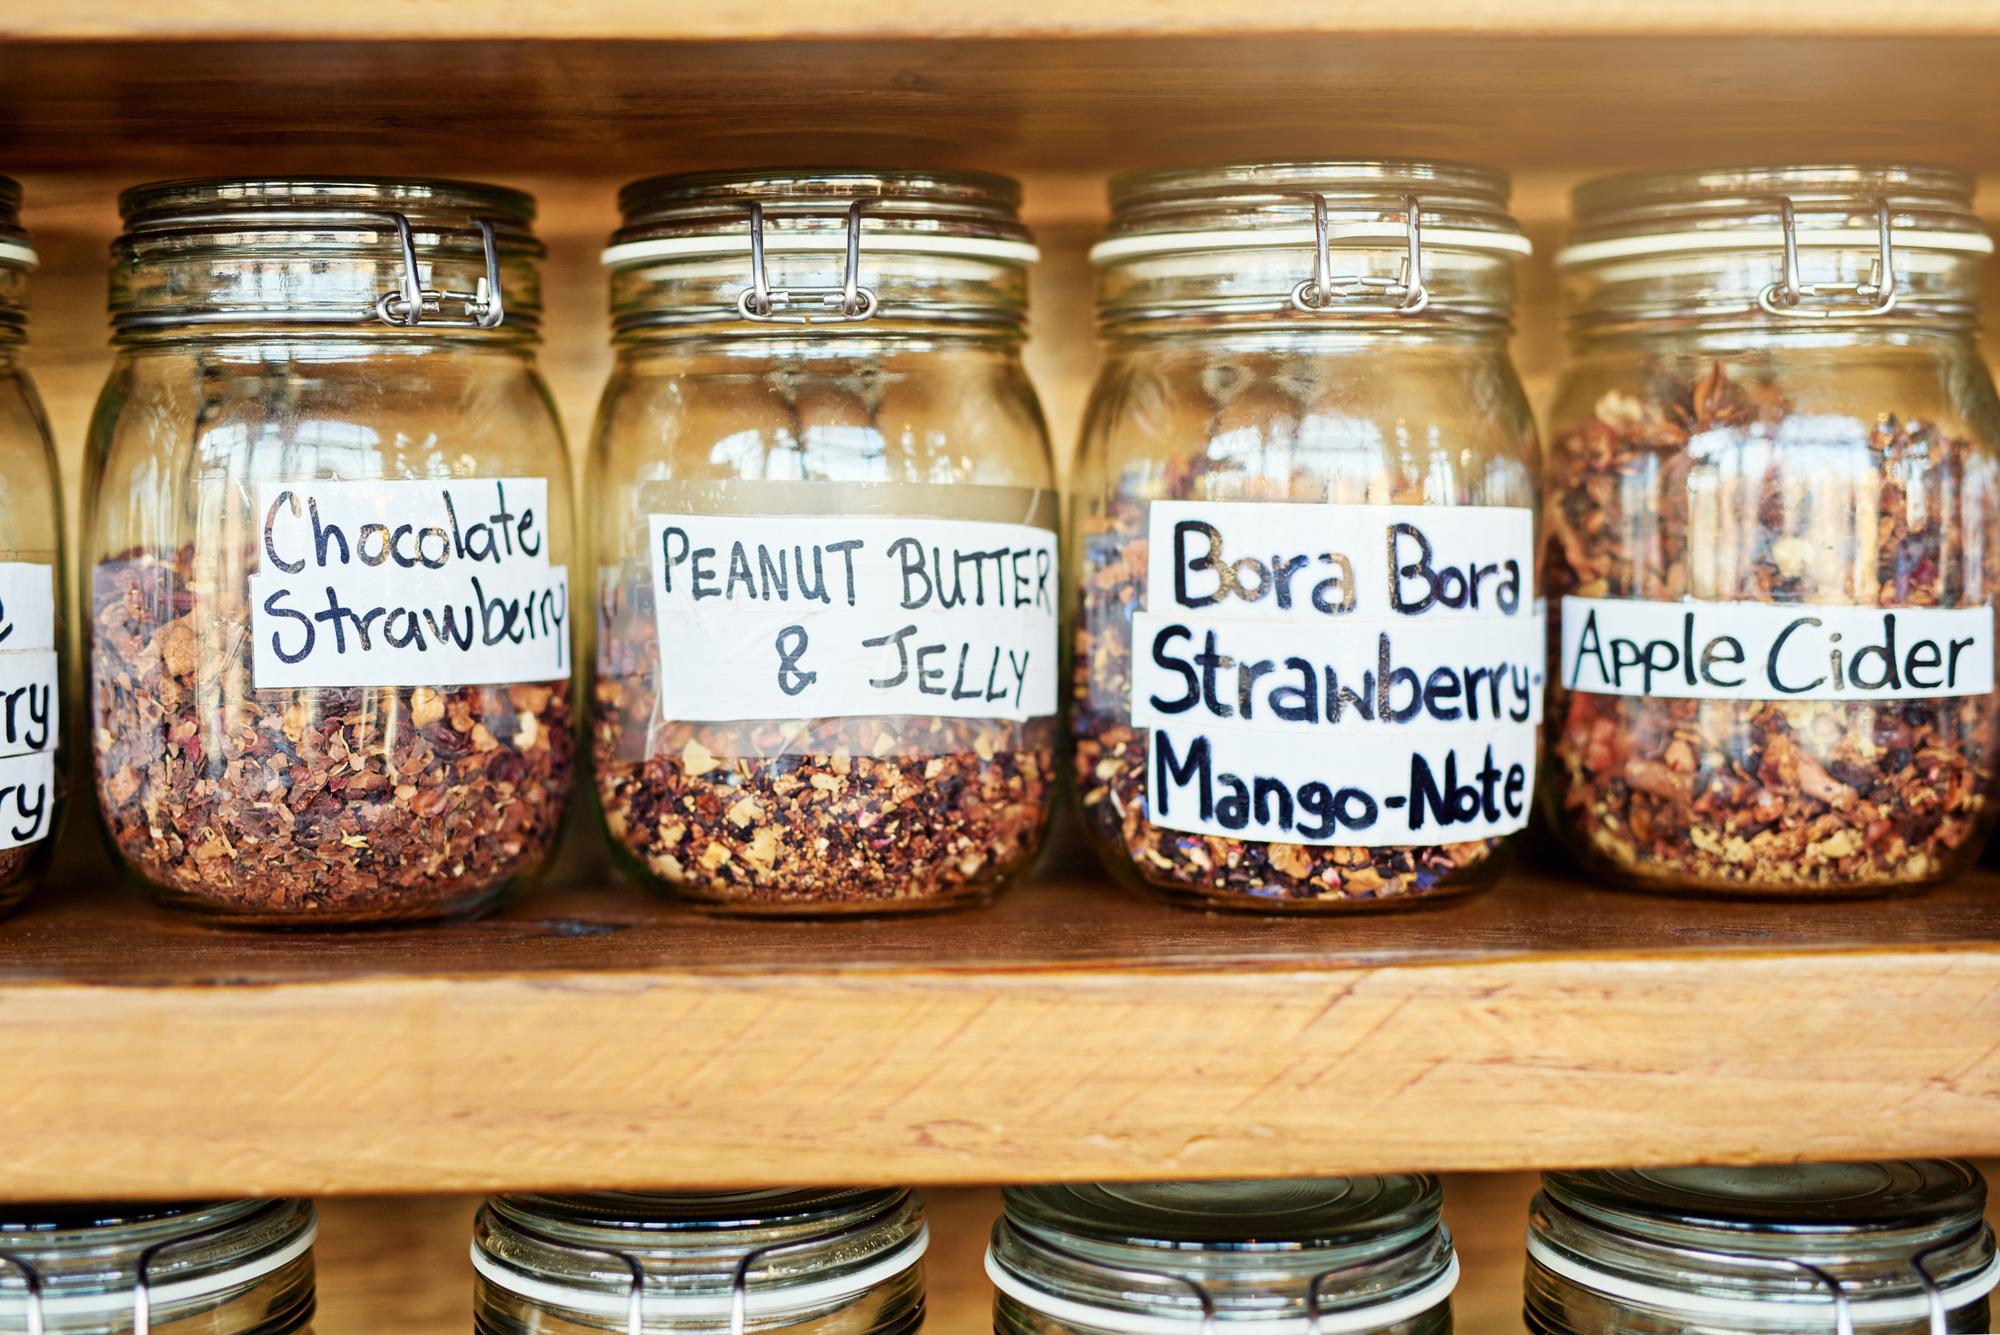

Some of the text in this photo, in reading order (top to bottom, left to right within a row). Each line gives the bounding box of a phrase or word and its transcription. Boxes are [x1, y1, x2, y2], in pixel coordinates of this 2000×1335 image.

[265, 482, 541, 574] Chocolate
[662, 527, 1052, 615] PEANUT BUTTER
[1174, 520, 1521, 617] Bora Bora
[263, 576, 566, 669] Strawberry
[774, 625, 1029, 709] & JELLY
[1572, 608, 1974, 694] Apple Cider
[1155, 729, 1526, 839] Mango-Note
